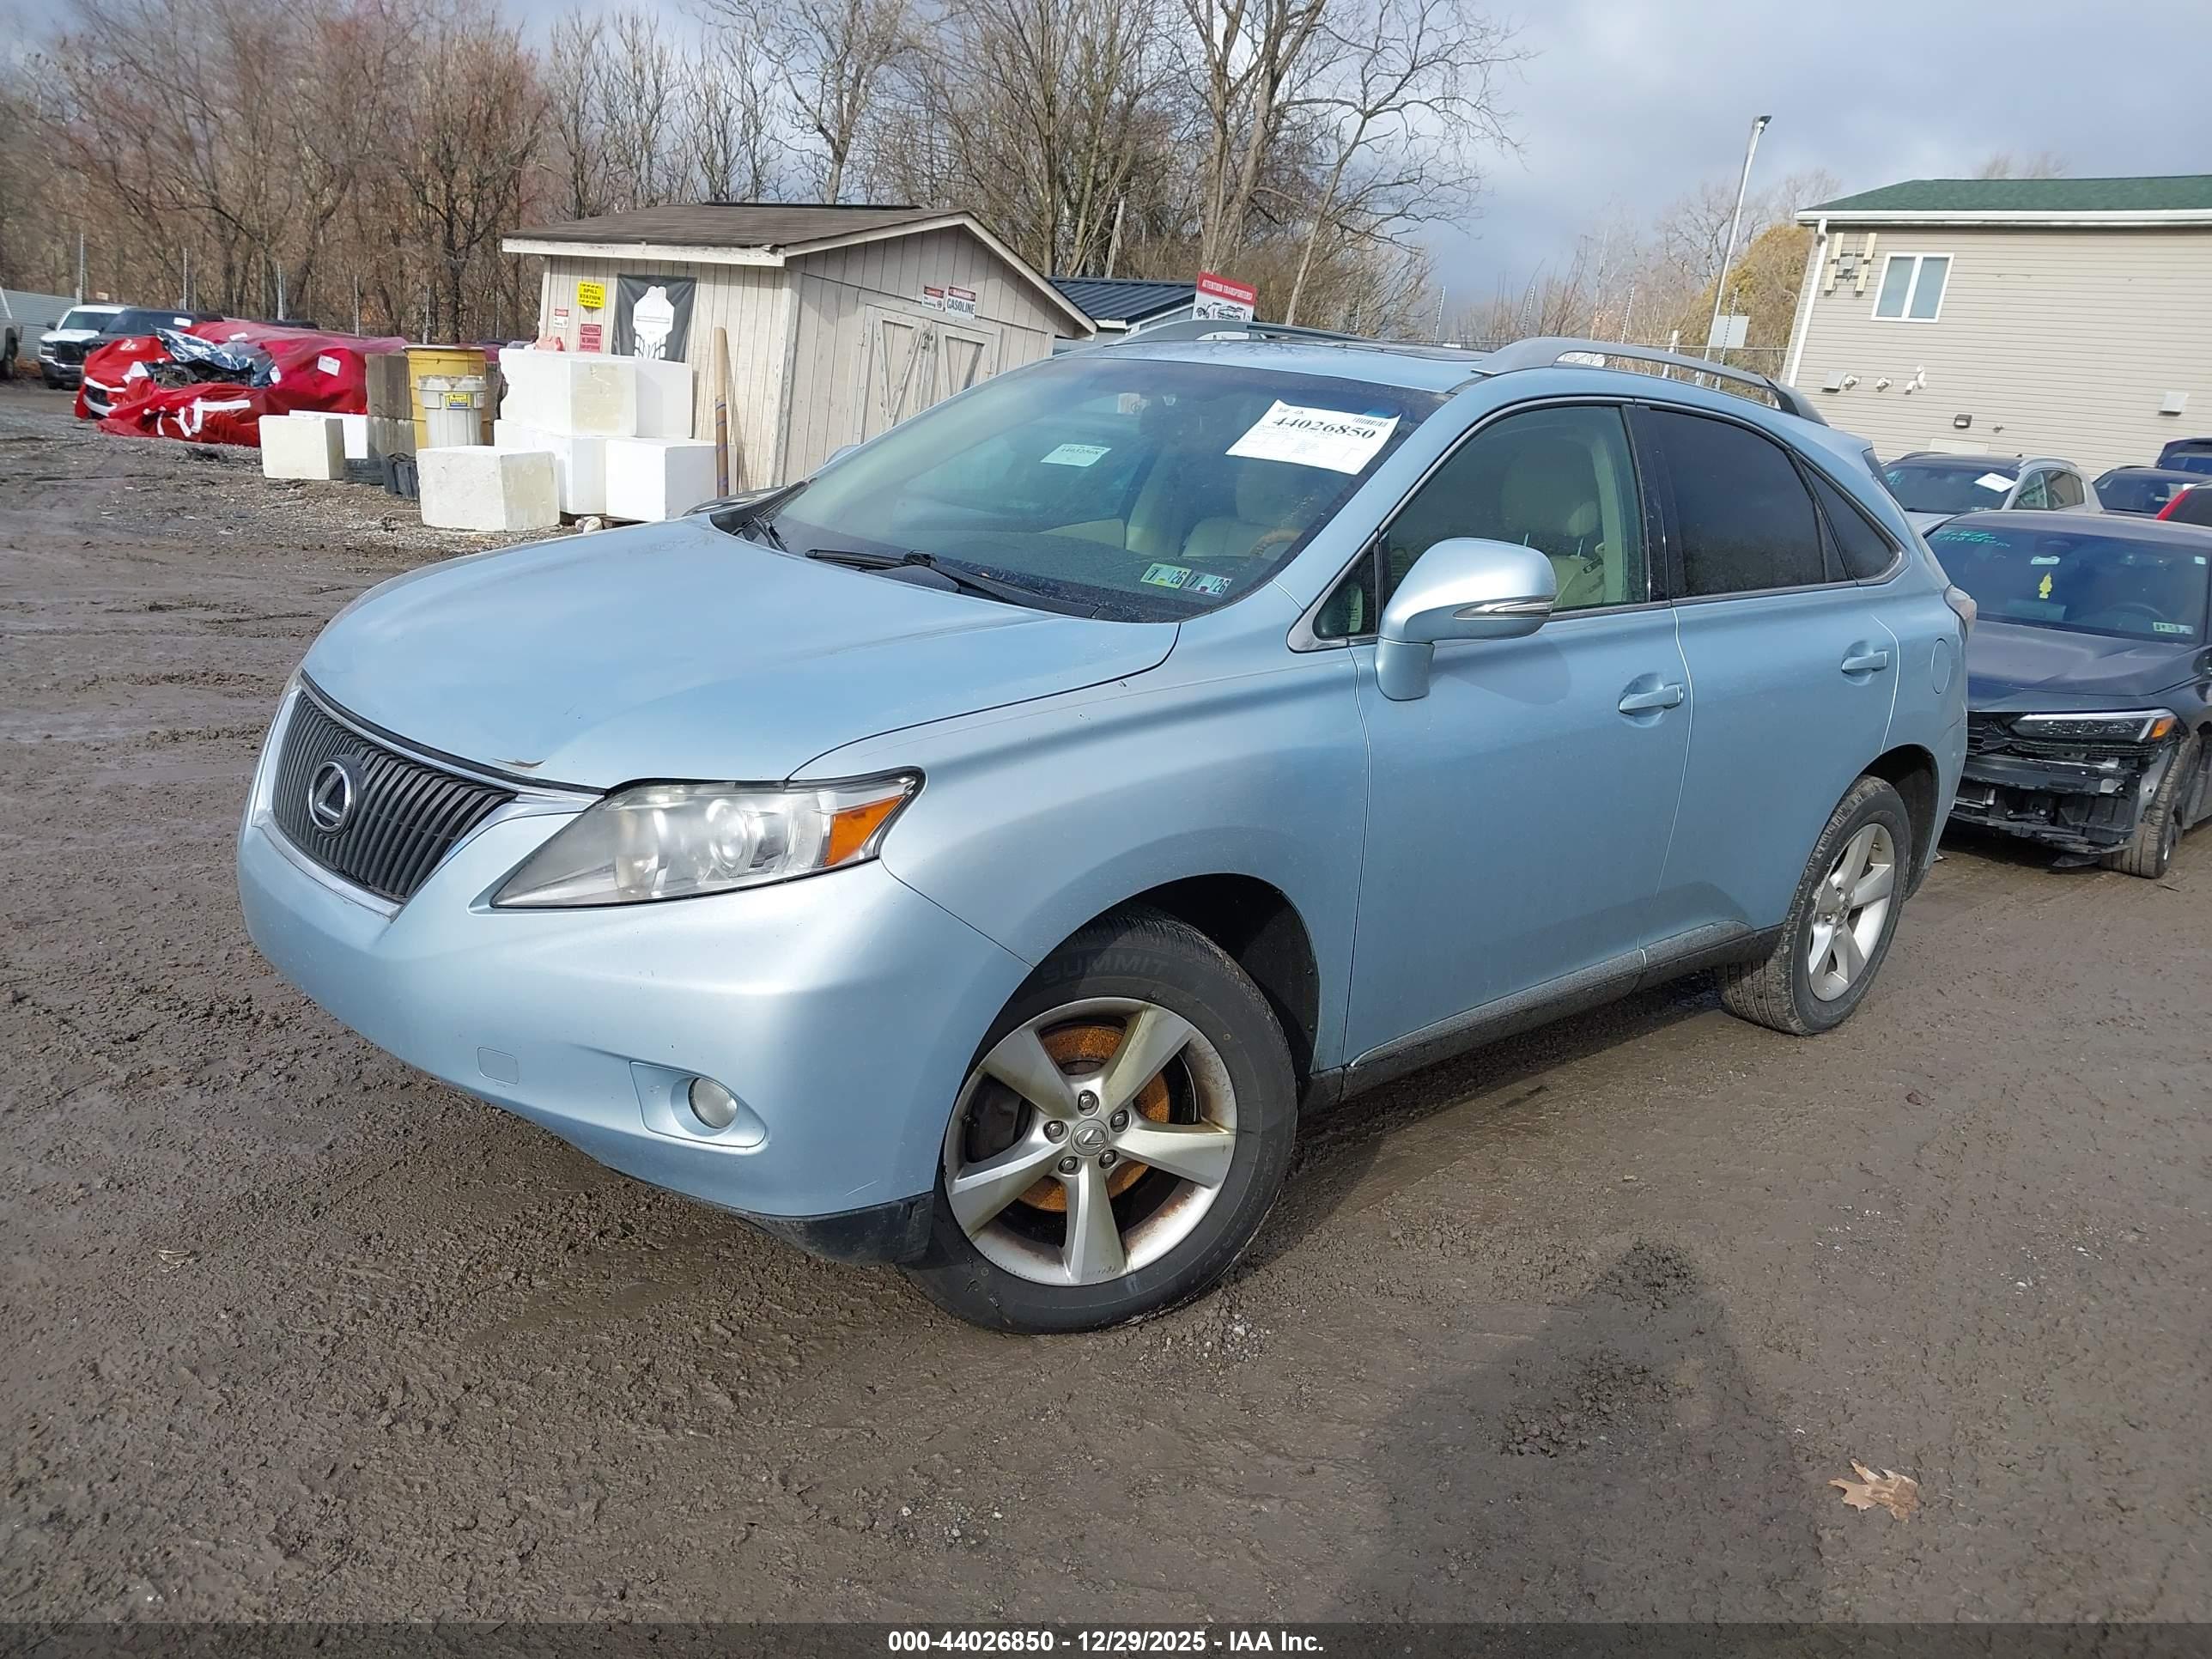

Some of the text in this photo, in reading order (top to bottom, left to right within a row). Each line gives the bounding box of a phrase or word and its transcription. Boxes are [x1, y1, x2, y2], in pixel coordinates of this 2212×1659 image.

[947, 298, 975, 314] GASOLINE
[1273, 416, 1376, 440] 44026850
[1147, 569, 1187, 585] 7 26
[1188, 575, 1230, 593] 7 26
